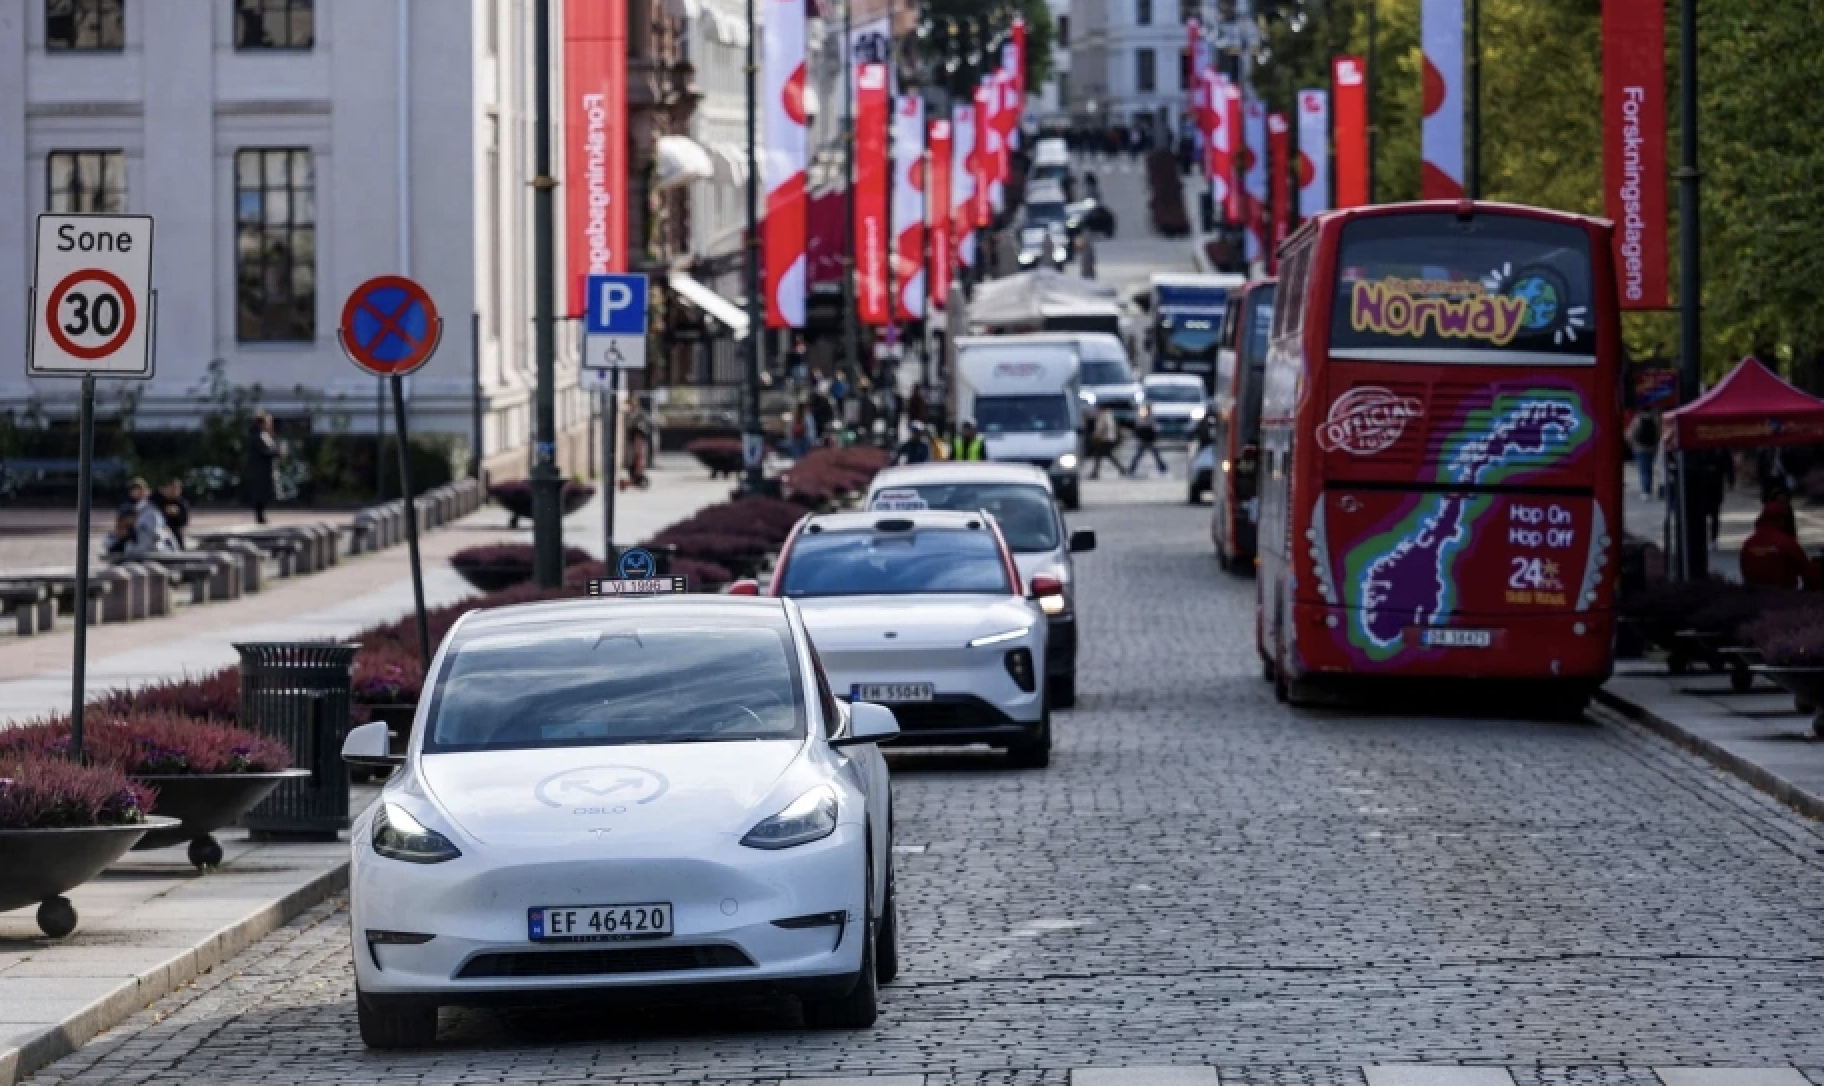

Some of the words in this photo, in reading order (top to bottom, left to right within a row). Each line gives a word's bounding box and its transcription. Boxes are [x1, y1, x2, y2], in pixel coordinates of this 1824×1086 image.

[1620, 86, 1645, 300] Forskningsdagene
[56, 223, 133, 252] Sone
[64, 292, 121, 336] 30
[601, 281, 633, 327] P
[1352, 280, 1526, 345] Norway
[1327, 399, 1425, 442] OFFICIAL
[1508, 504, 1543, 525] Hop
[1547, 504, 1572, 524] On
[1508, 528, 1543, 548] Hop
[1547, 528, 1574, 548] Off
[1508, 556, 1543, 589] 24
[573, 806, 627, 815] OSLO
[551, 911, 577, 933] EF
[588, 907, 665, 933] 46420
